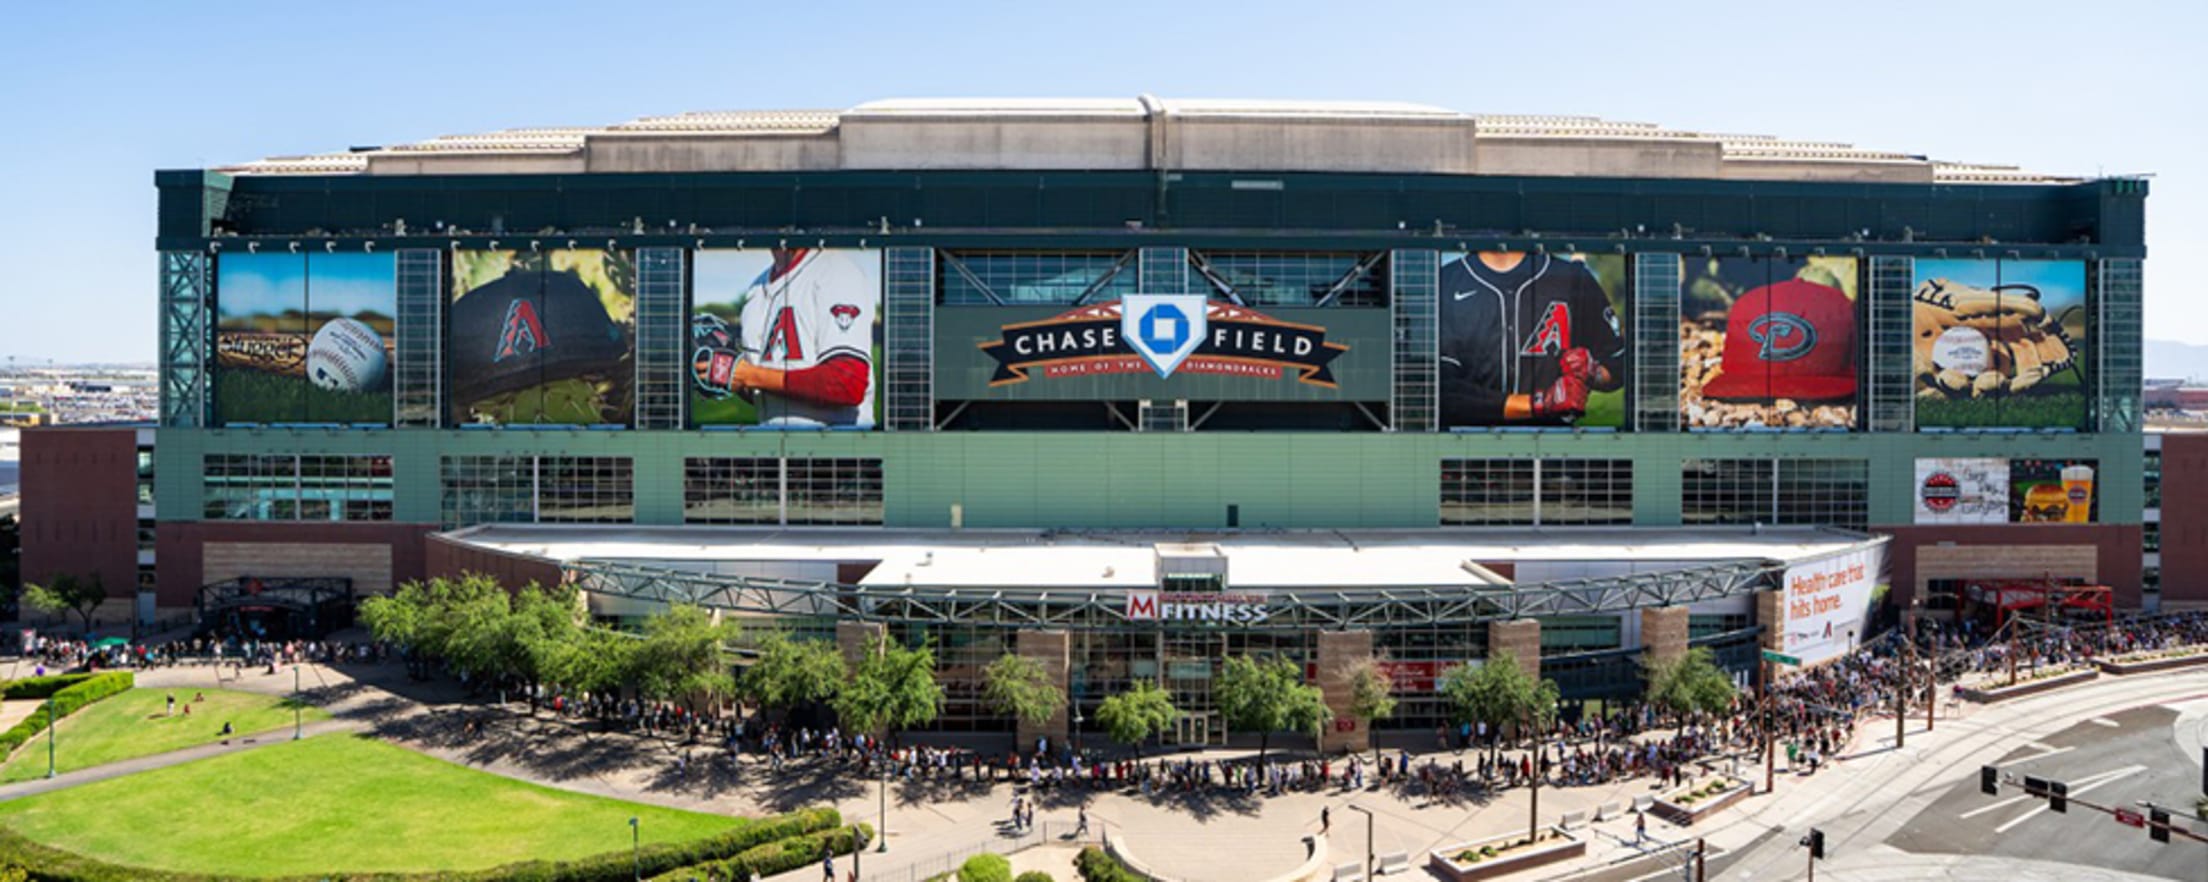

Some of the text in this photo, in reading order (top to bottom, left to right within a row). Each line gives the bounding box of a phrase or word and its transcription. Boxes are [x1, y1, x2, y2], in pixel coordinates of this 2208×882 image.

[1015, 328, 1313, 356] CHASE FIELD
[1051, 363, 1086, 375] HOME
[1118, 360, 1142, 370] THE
[1186, 361, 1277, 376] DIAMONDBACKS
[1790, 563, 1864, 597] Health care that
[1129, 595, 1156, 619] M
[1161, 603, 1268, 621] FITNESS
[1790, 598, 1811, 621] hits
